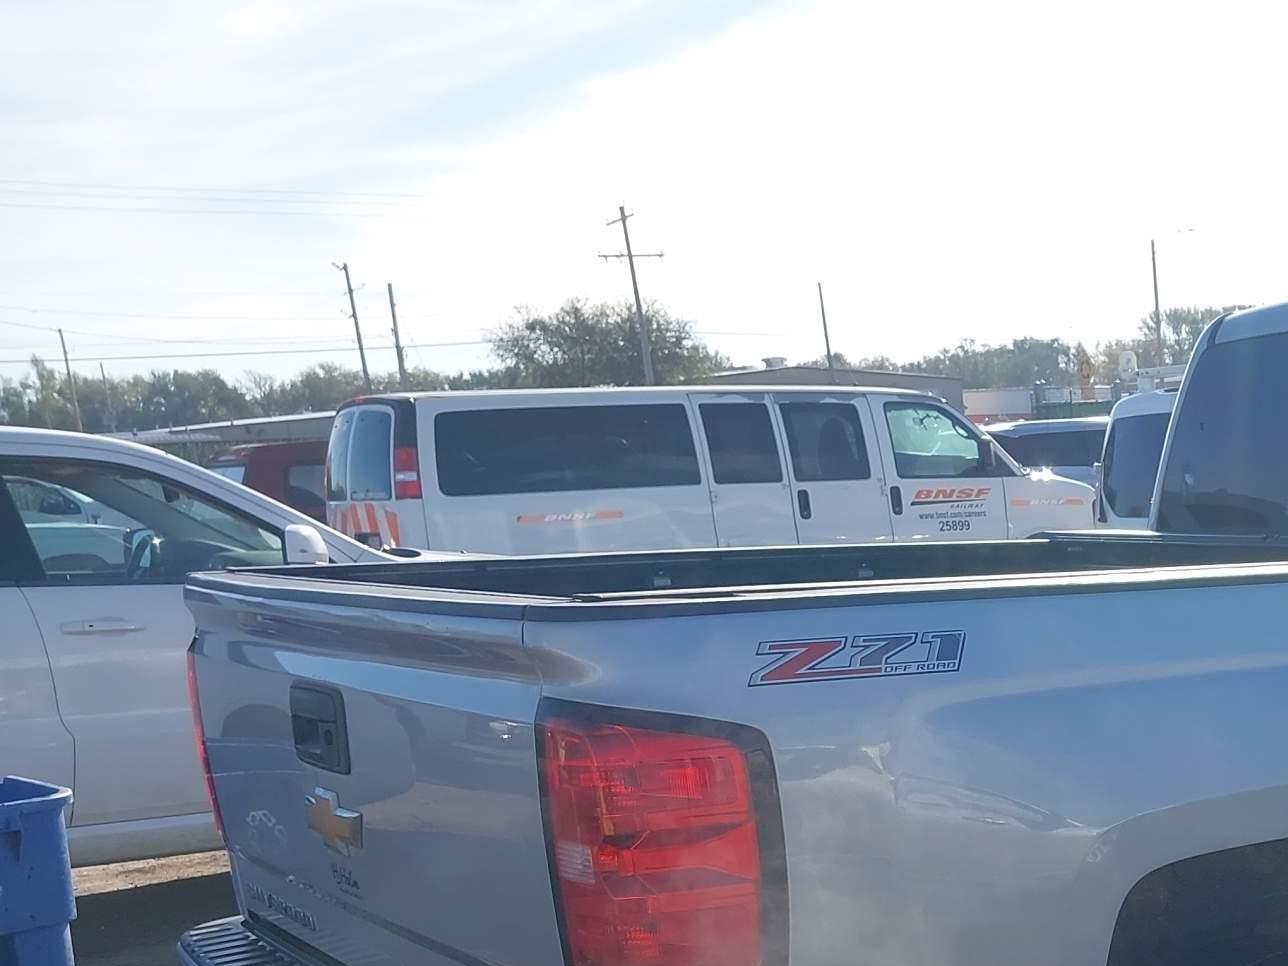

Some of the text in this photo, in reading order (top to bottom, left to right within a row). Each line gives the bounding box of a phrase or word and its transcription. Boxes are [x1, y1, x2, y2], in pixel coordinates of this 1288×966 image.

[915, 488, 991, 499] BNSF
[938, 519, 971, 533] 25899
[747, 630, 966, 687] Z71
[883, 660, 956, 674] OFF ROAD
